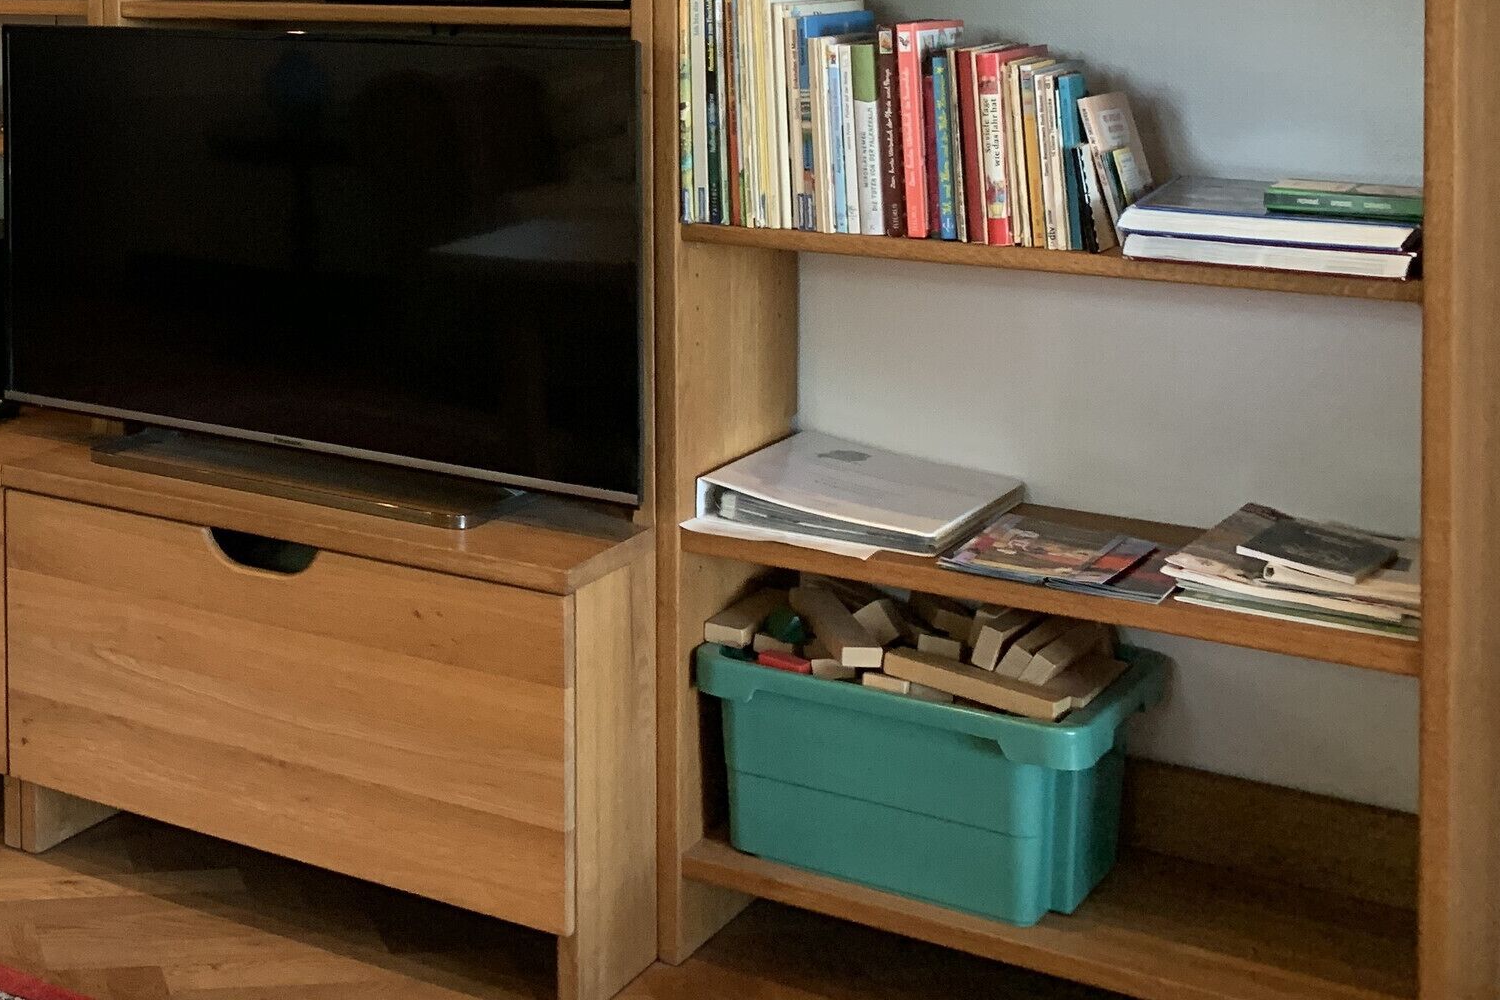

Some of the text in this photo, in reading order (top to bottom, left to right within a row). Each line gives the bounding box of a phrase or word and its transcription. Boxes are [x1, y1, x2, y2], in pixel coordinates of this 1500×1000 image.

[982, 98, 990, 116] Tage
[990, 98, 998, 112] hat
[984, 142, 991, 153] So
[1048, 227, 1056, 240] dtv
